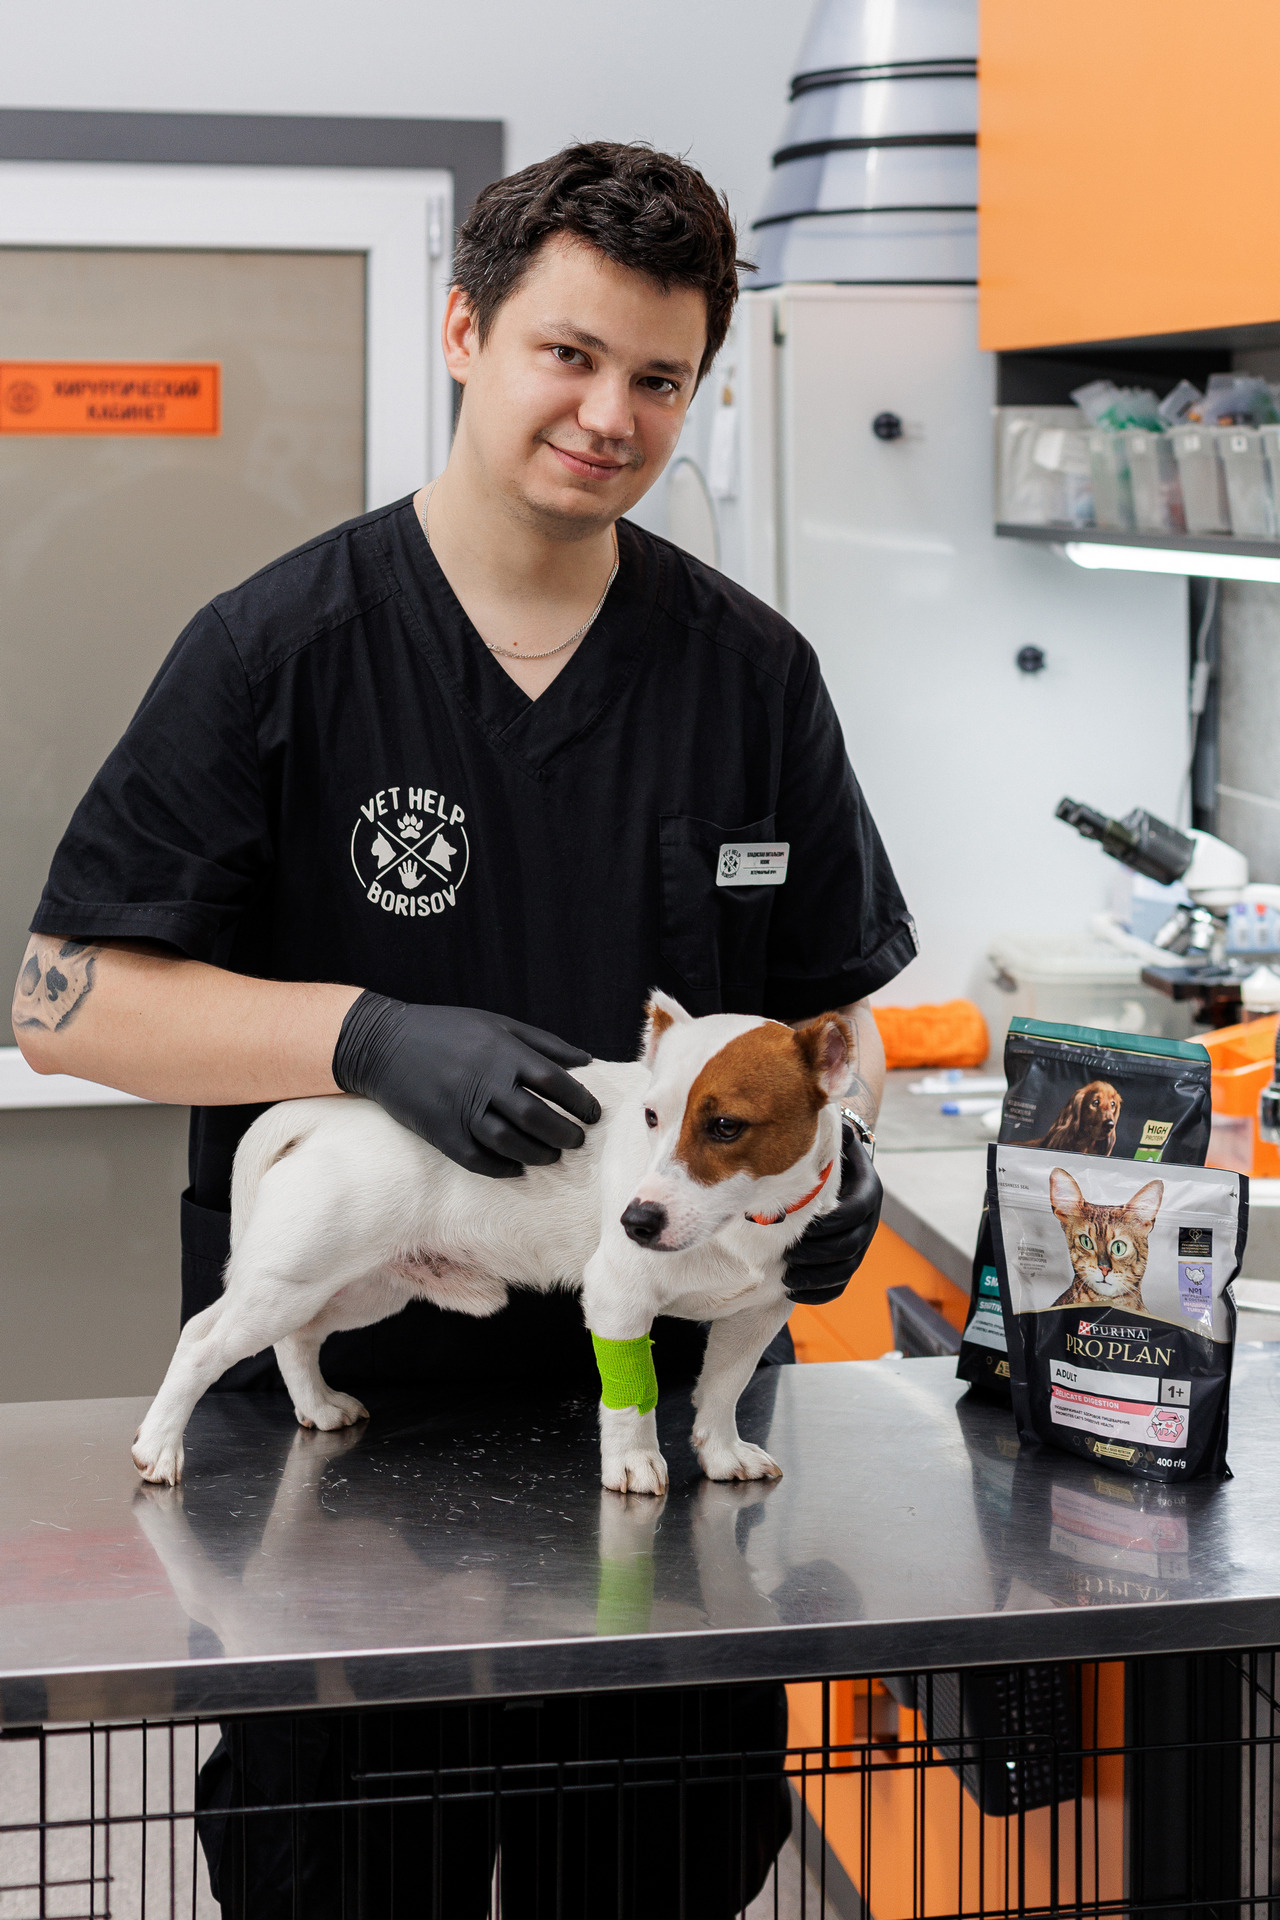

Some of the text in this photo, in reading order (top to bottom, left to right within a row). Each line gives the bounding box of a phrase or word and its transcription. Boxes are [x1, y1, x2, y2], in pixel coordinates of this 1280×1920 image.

[87, 403, 166, 421] КАБИНЕТ
[360, 787, 465, 825] VET HELP
[367, 880, 456, 916] BORISOV
[1147, 1125, 1168, 1134] HIGH
[1092, 1325, 1146, 1340] PURINA
[1066, 1333, 1172, 1367] PRO PLAN
[1056, 1368, 1077, 1382] ADULT
[1055, 1388, 1119, 1409] DELICATE DIGESTION
[1167, 1385, 1184, 1398] 1+
[1156, 1457, 1172, 1467] 400
